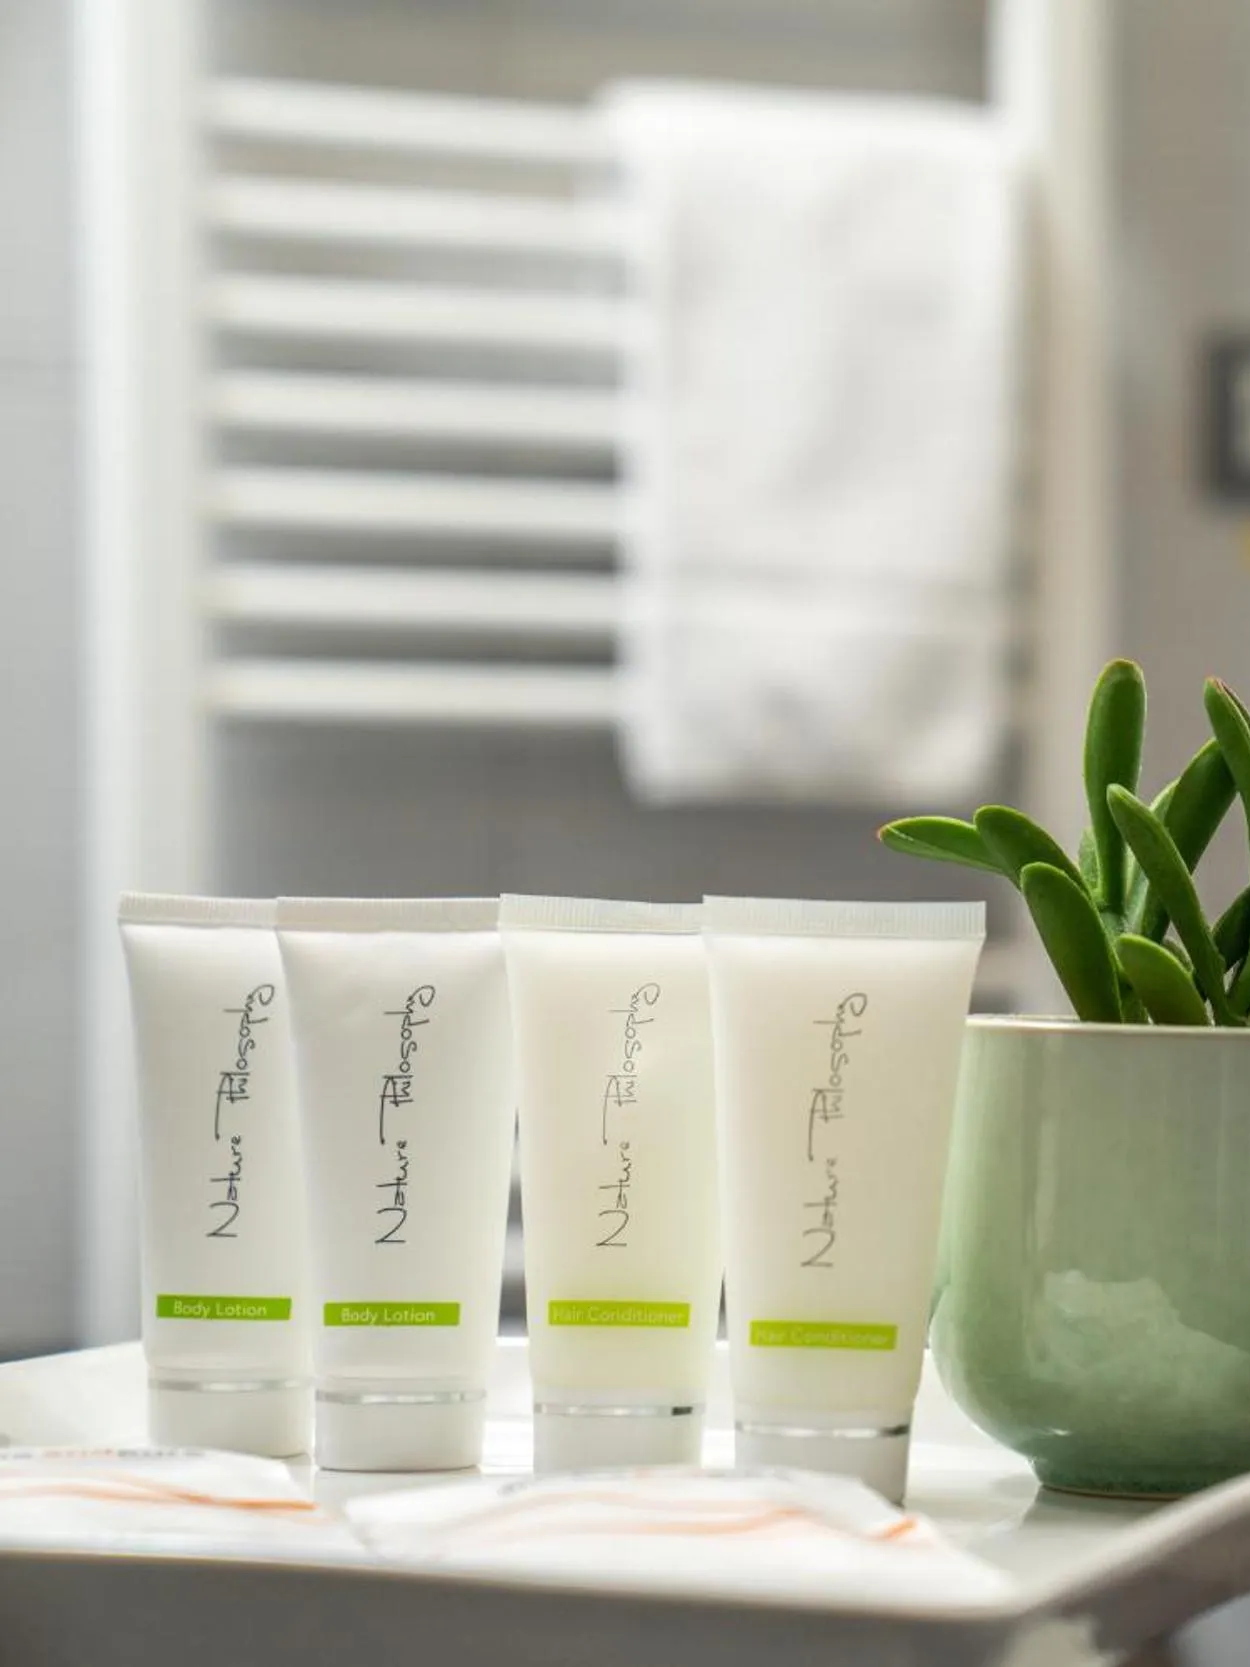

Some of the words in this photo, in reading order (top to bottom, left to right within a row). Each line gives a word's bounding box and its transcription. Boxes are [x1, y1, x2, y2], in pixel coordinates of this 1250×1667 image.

[214, 984, 275, 1140] Philosophy
[379, 985, 436, 1146] Philosophy
[602, 982, 661, 1146] Philosophy
[808, 992, 868, 1162] Philosophy
[206, 1135, 242, 1238] Nature
[374, 1140, 408, 1244] Nature
[596, 1141, 632, 1247] Nature
[801, 1157, 839, 1267] Nature
[173, 1299, 210, 1317] Body
[215, 1300, 267, 1318] Lotion
[341, 1306, 378, 1324] Body
[383, 1307, 436, 1323] Lotion
[553, 1306, 583, 1322] Hair
[587, 1306, 685, 1324] Conditioner
[791, 1328, 888, 1346] Conditioner
